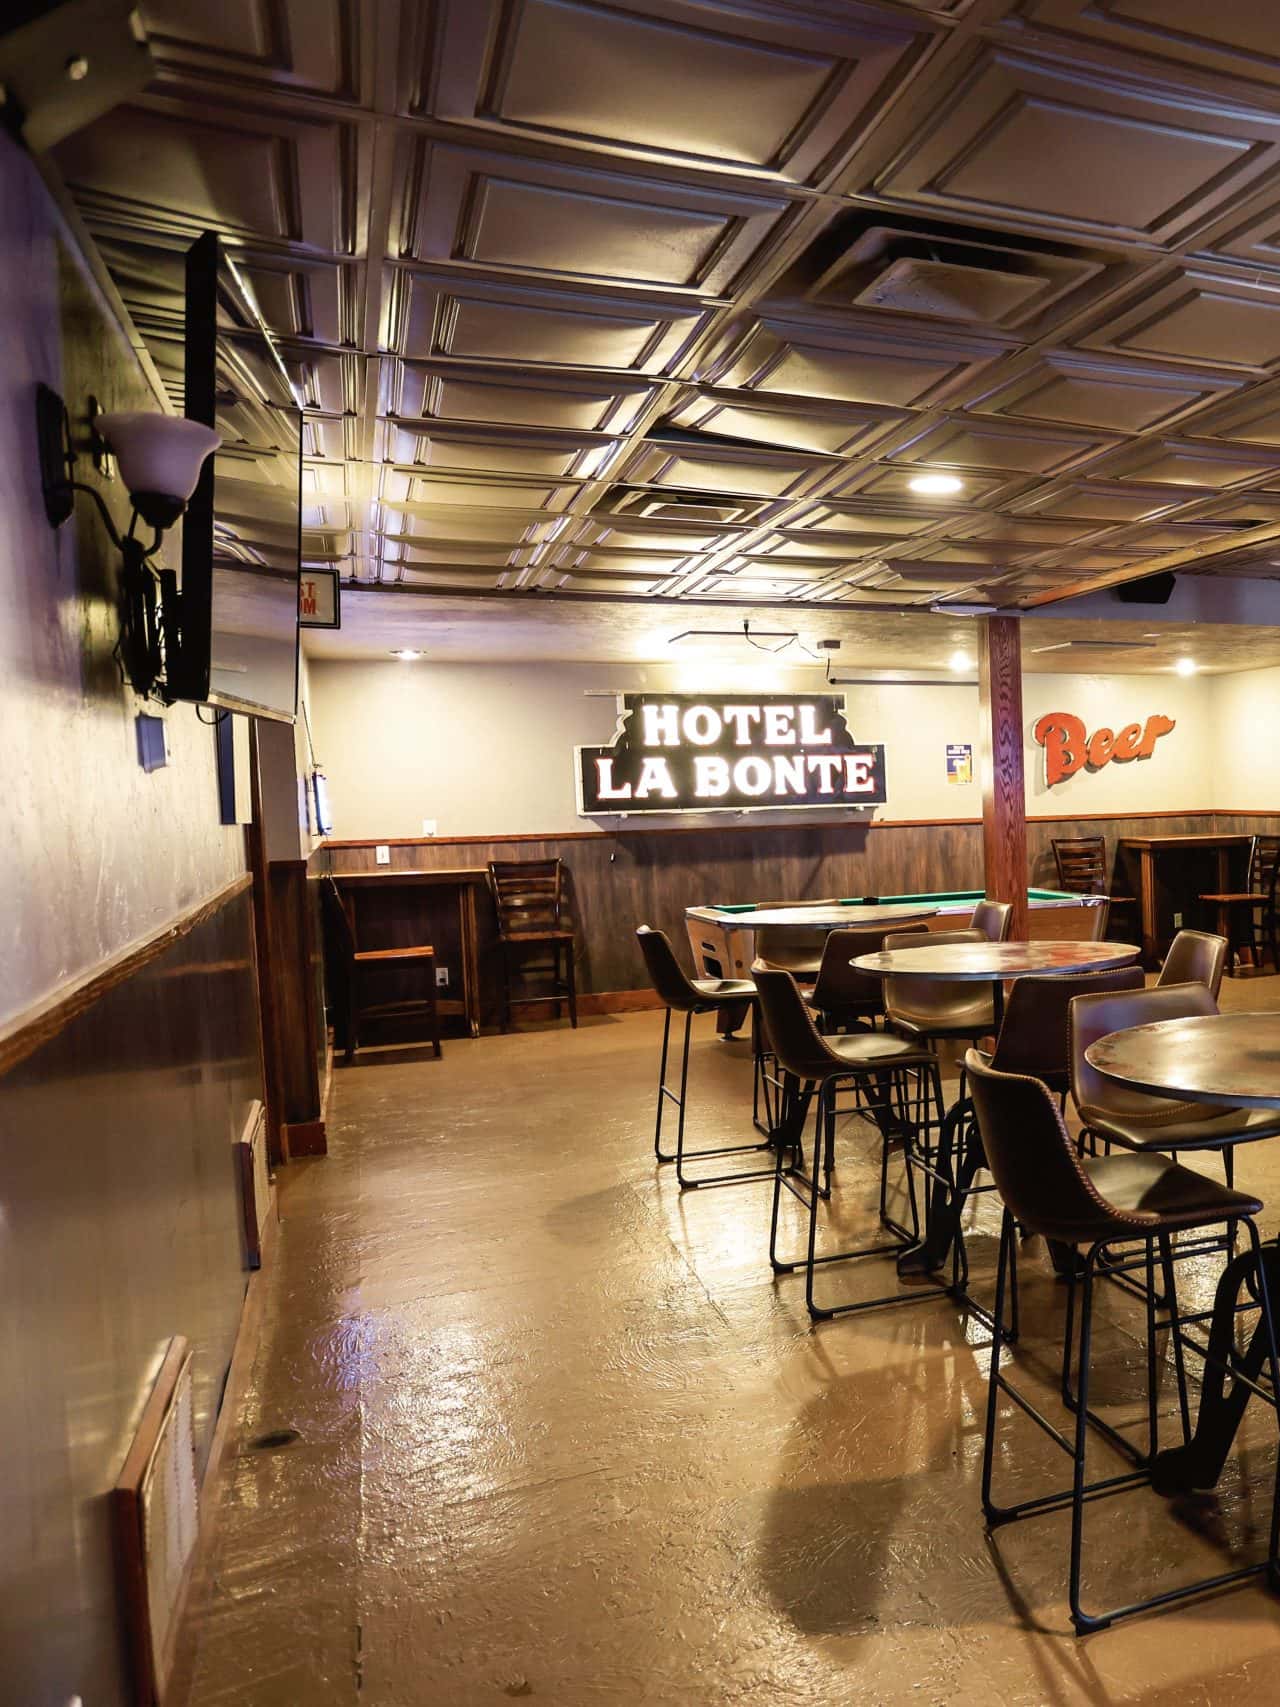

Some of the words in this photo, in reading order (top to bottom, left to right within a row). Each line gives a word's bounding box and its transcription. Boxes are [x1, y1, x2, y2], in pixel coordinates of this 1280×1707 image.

[643, 704, 833, 747] HOTEL
[1034, 711, 1177, 788] Beer
[595, 756, 678, 800] LA
[693, 754, 874, 798] BONTE
